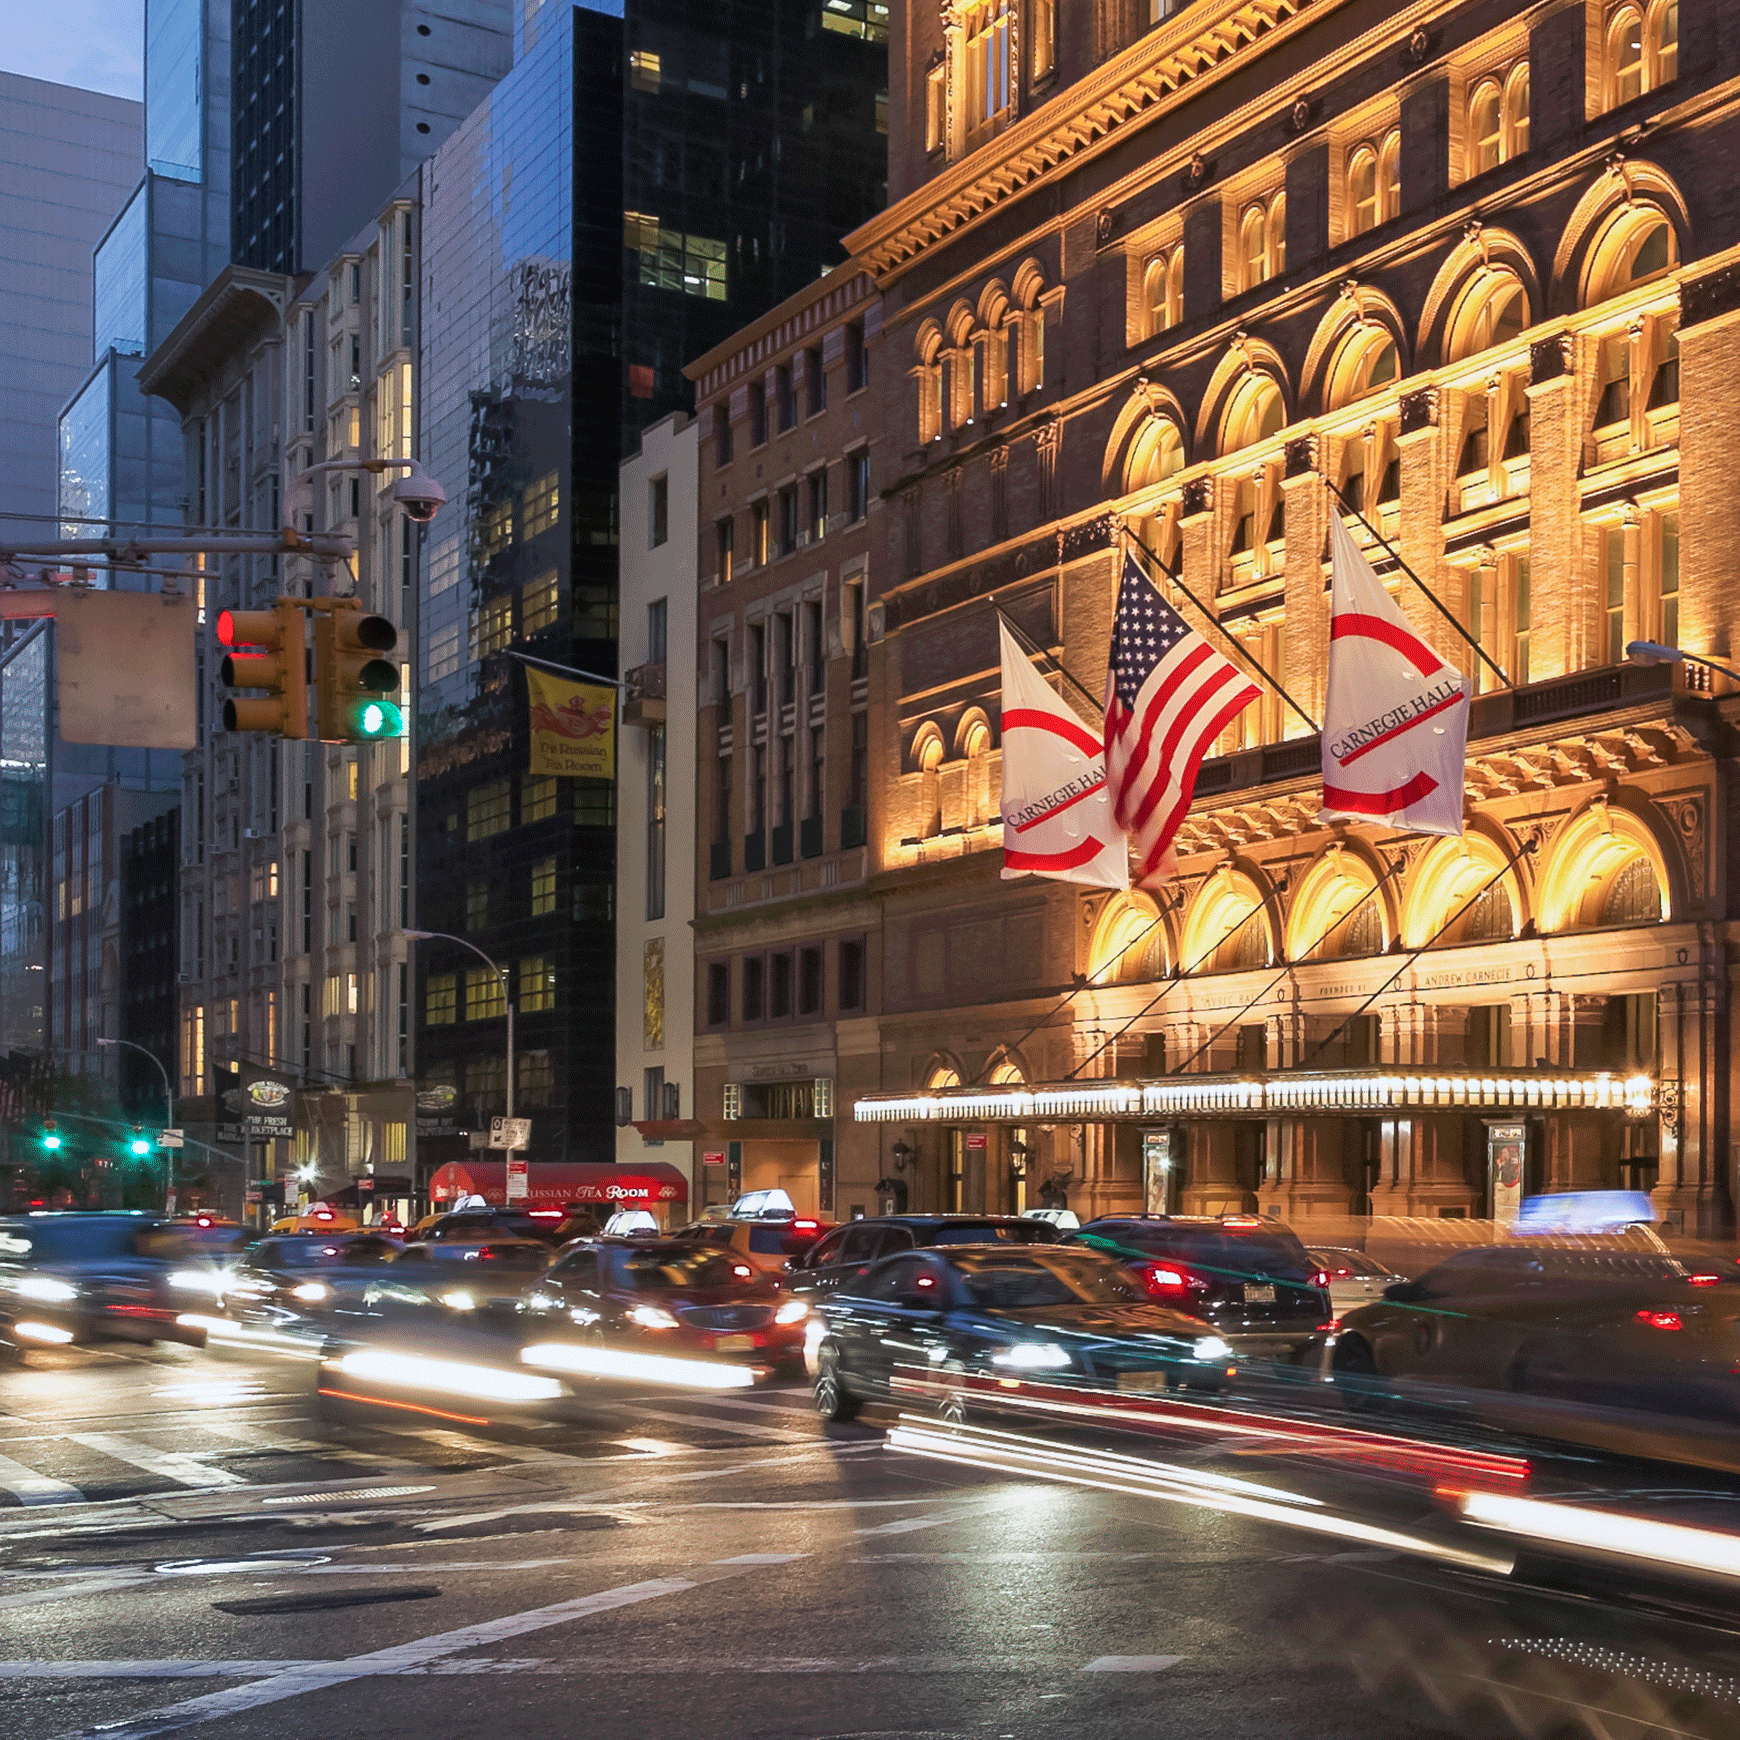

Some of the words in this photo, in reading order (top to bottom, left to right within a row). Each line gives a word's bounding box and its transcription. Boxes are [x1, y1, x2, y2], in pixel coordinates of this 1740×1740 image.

[1330, 704, 1413, 759] CARNEGIE
[1410, 680, 1460, 715] HALL
[1006, 781, 1081, 827] CARNEGIE
[1076, 764, 1107, 790] HAL
[1425, 972, 1462, 986] ANDREW
[1466, 968, 1511, 983] CARNEGIE
[527, 1188, 572, 1199] USSIAN
[606, 1185, 649, 1199] ROOM
